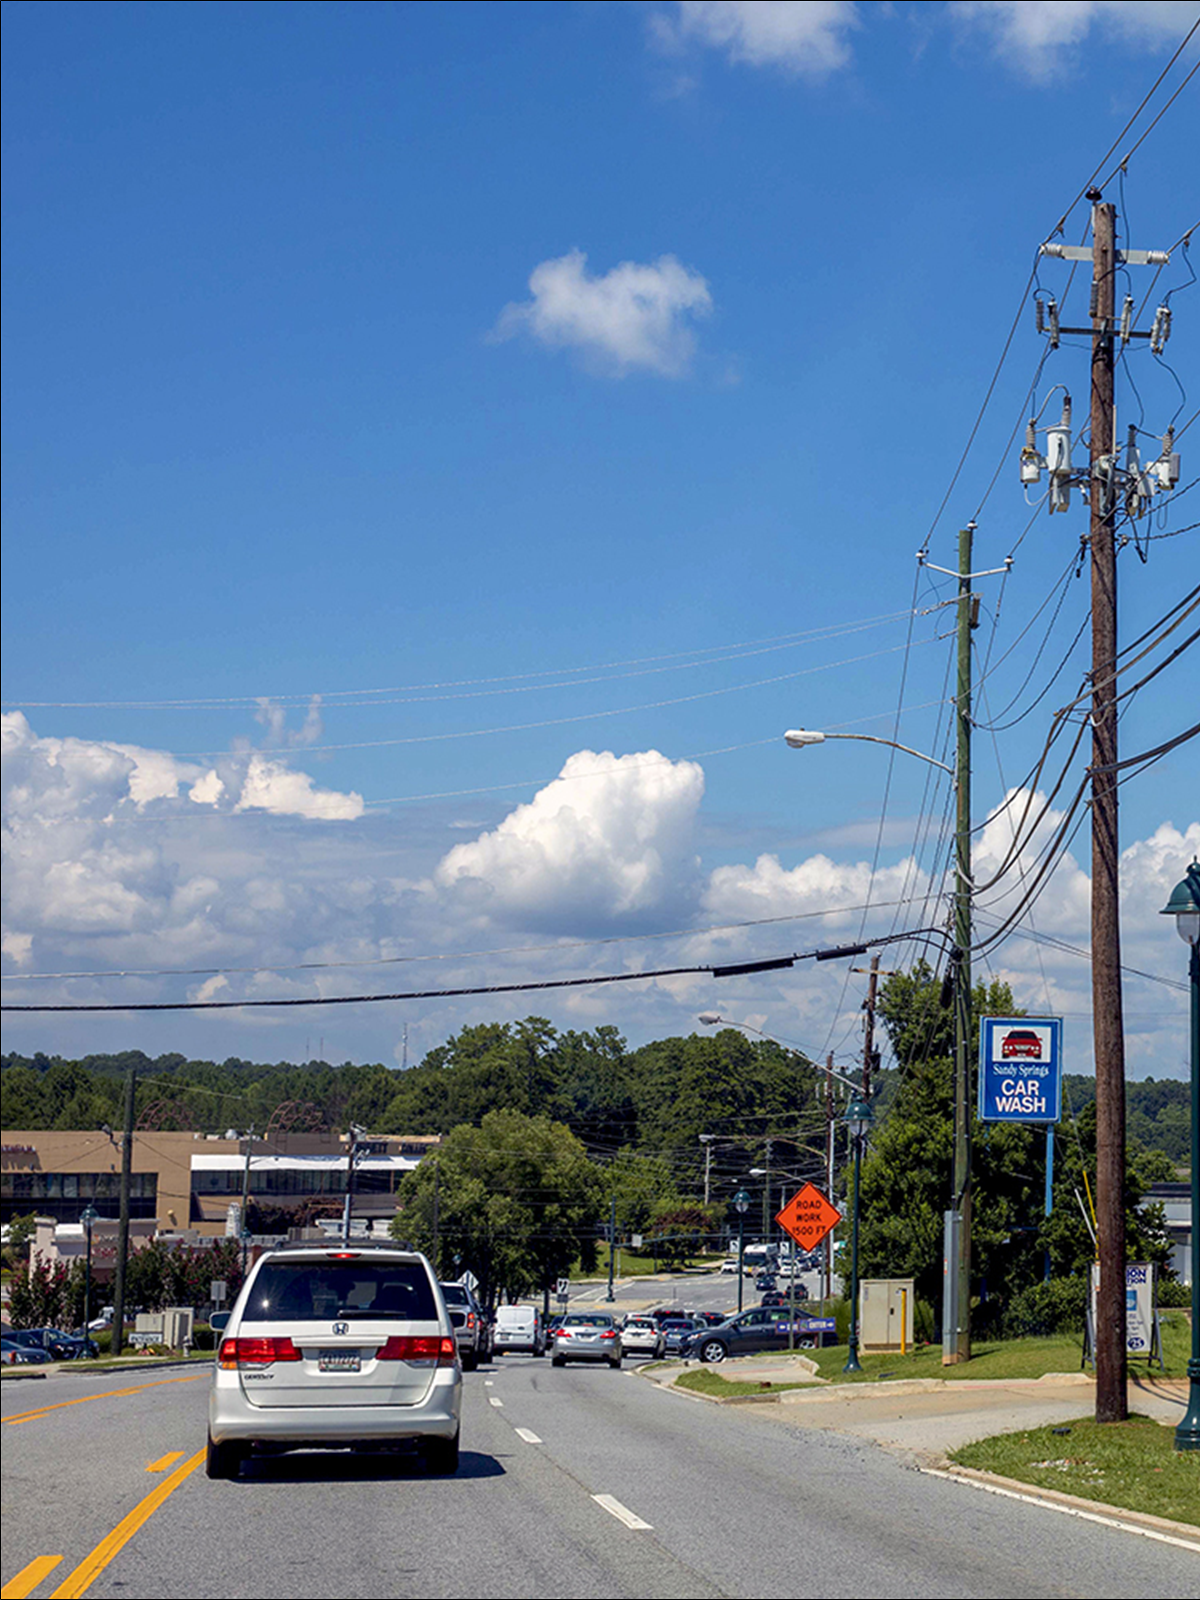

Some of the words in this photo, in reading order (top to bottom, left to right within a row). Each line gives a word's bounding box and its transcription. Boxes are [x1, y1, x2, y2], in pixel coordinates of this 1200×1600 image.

[993, 1063, 1017, 1077] Sandy
[1018, 1064, 1049, 1078] Springs
[1001, 1079, 1039, 1097] CAR
[995, 1096, 1046, 1113] WASH
[796, 1200, 822, 1210] ROAD
[796, 1213, 822, 1222] WORK
[792, 1226, 814, 1236] 1500
[816, 1226, 826, 1235] FT
